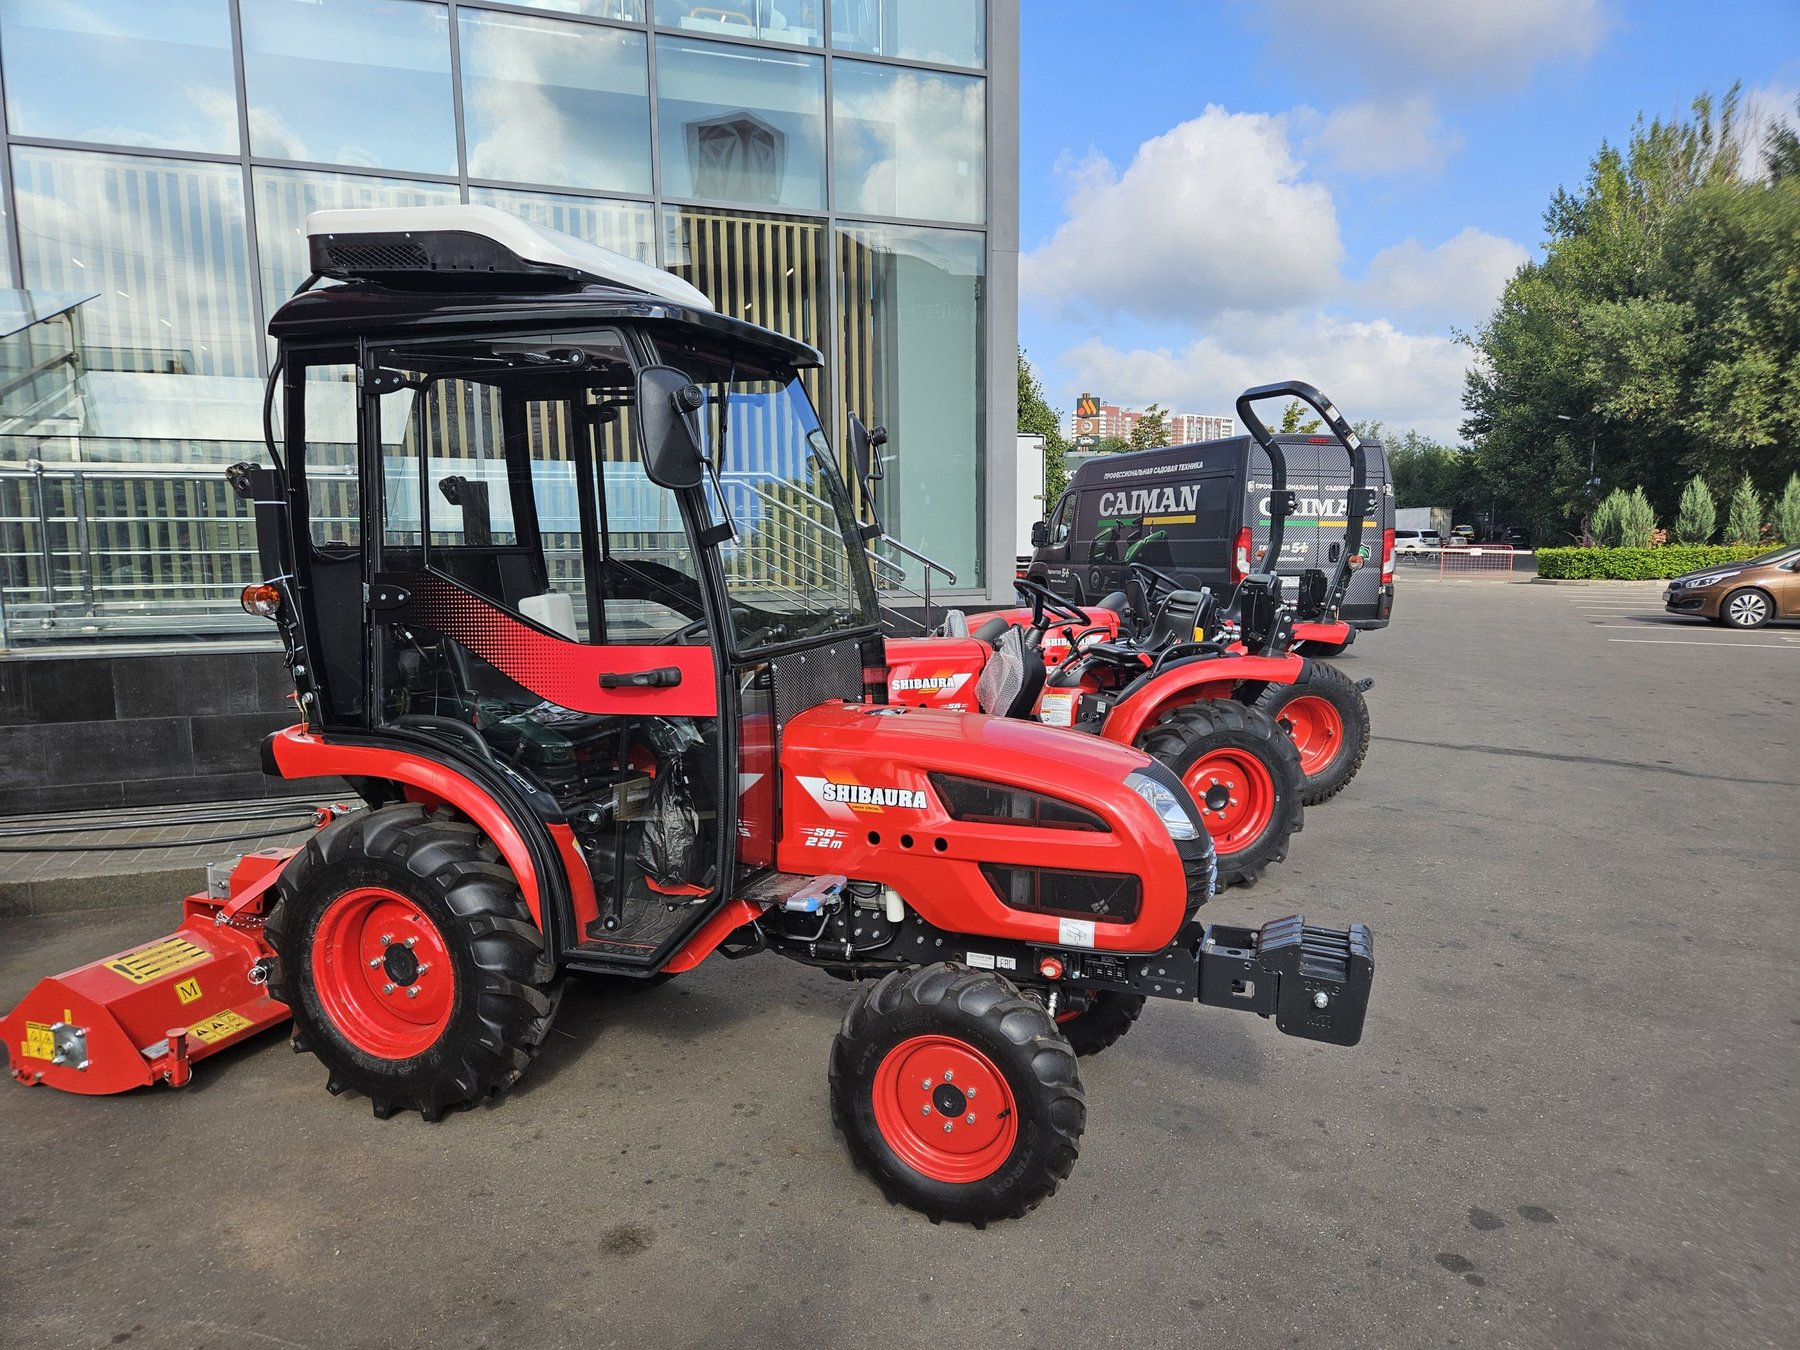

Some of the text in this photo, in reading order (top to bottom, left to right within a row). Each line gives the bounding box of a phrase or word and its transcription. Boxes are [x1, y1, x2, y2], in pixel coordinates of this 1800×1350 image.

[1104, 461, 1204, 480] ПРОФЕССИОНАЛЬНАЯ САДОВАЯ ТЕХНИКА
[1255, 483, 1319, 491] ПРОФОНАЛЬНАЯ
[1099, 484, 1202, 517] CAIMAN
[891, 676, 956, 690] SHIBAURA
[823, 782, 928, 809] SHIBAURA
[814, 828, 836, 838] SB
[180, 981, 198, 1000] M
